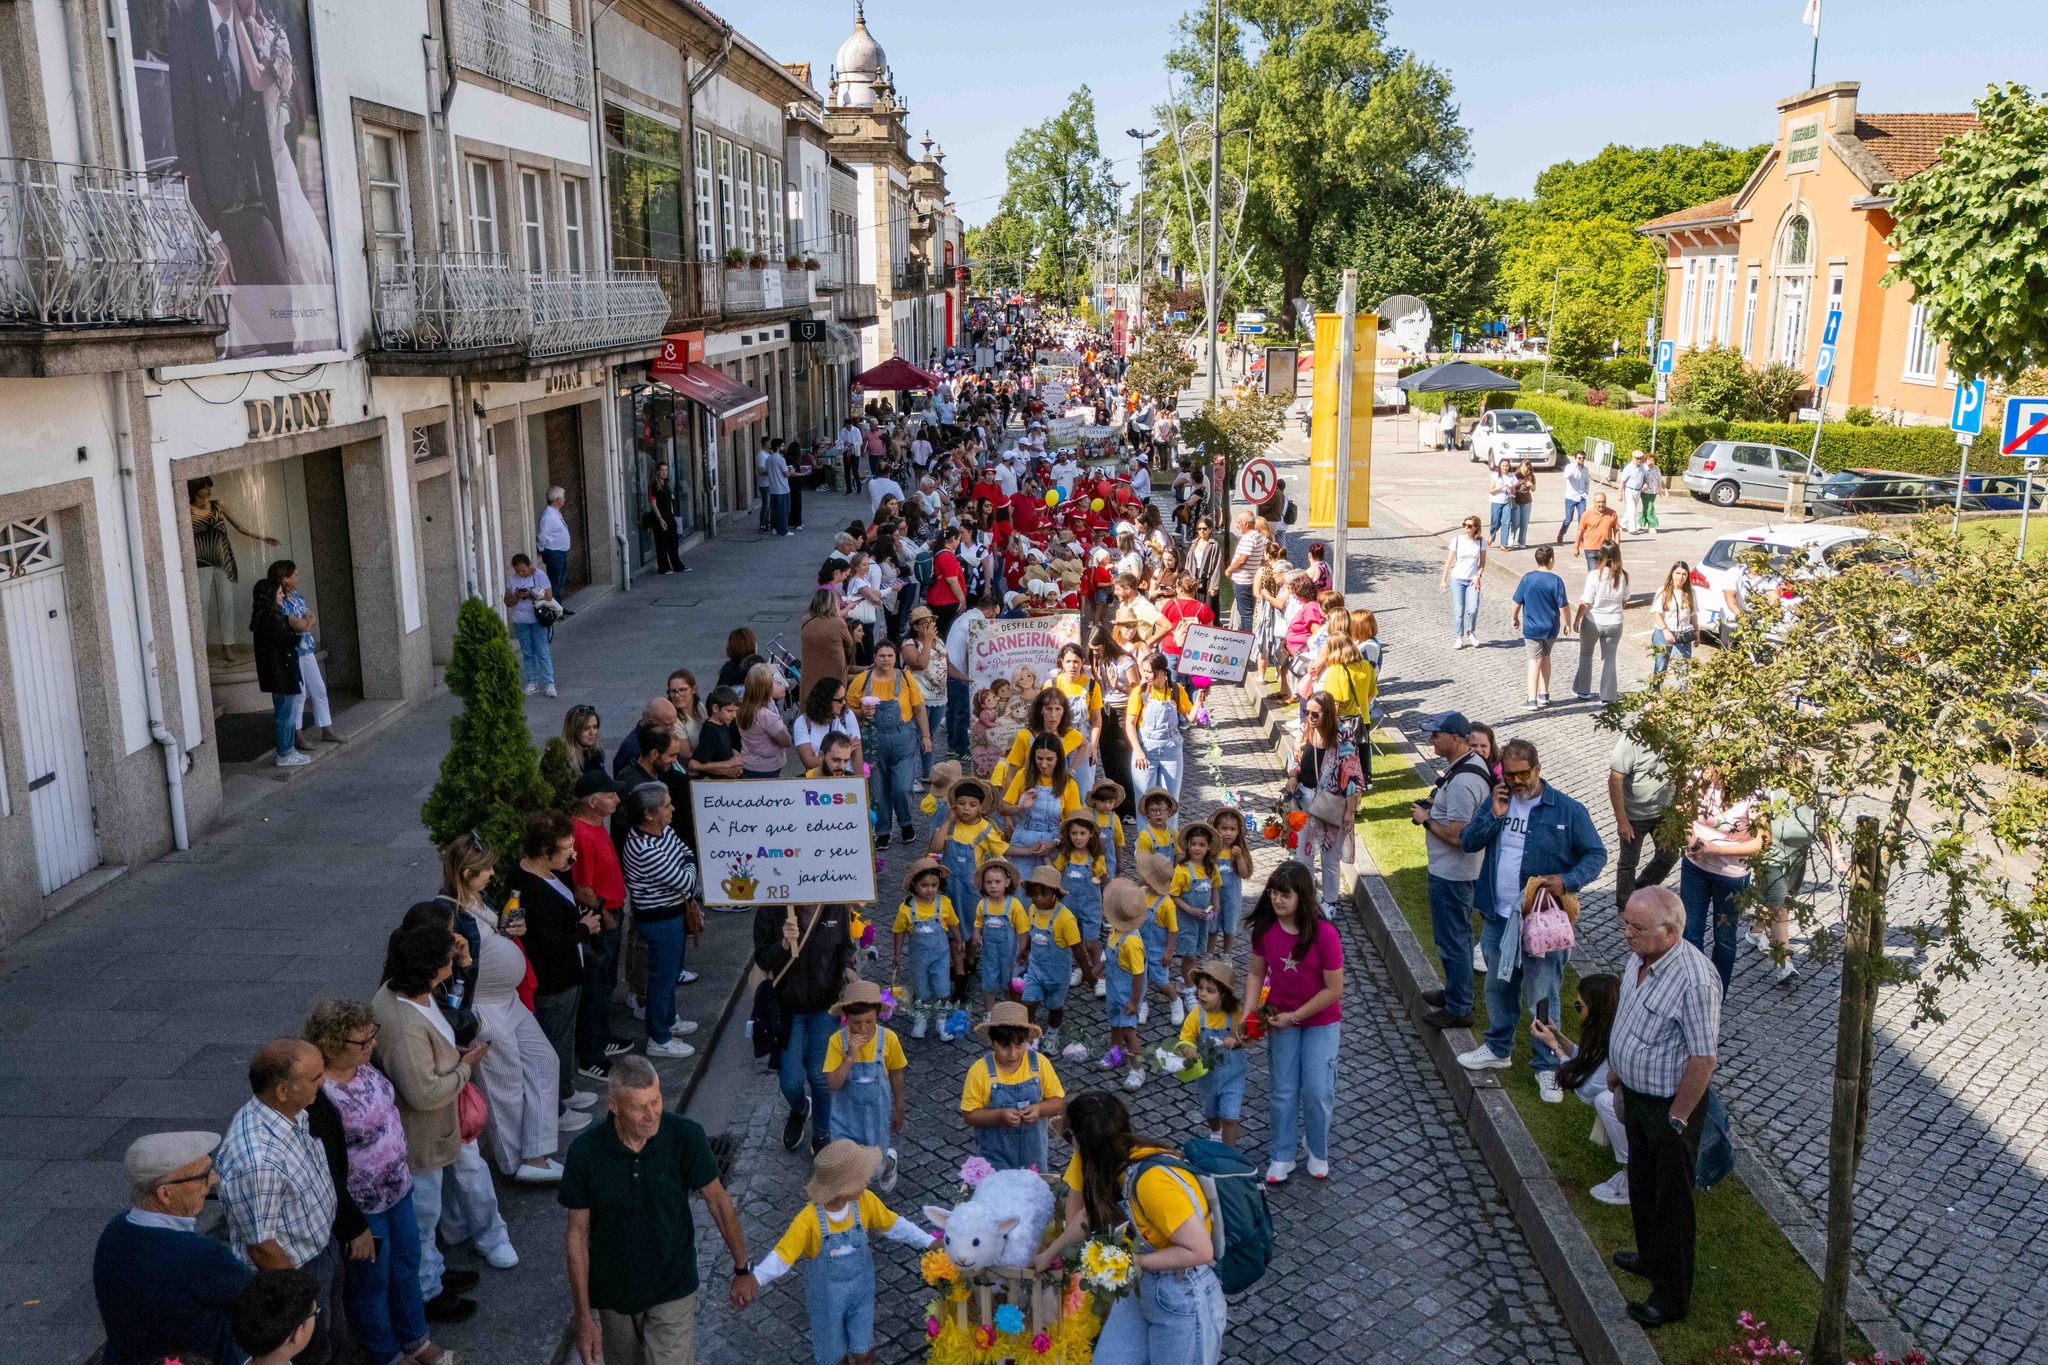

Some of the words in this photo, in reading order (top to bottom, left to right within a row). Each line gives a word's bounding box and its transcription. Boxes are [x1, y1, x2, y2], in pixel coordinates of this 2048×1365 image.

[1659, 343, 1671, 370] P
[1817, 350, 1831, 383] P
[1957, 384, 1978, 426] P
[244, 389, 335, 439] DANY
[1001, 621, 1034, 632] DESFILE
[1037, 621, 1049, 629] DO
[1194, 629, 1209, 639] Hoje
[1213, 634, 1246, 645] queremos
[1208, 643, 1228, 651] dizer
[992, 656, 1033, 670] Professora
[1183, 648, 1245, 668] OBRIGADA
[1210, 667, 1230, 676] tudo
[704, 795, 795, 808] Educadora
[804, 790, 858, 806] Rosa
[728, 820, 759, 837] flor
[765, 823, 798, 837] que
[806, 819, 858, 832] educa
[710, 849, 745, 859] com
[756, 846, 801, 859] Amor
[814, 847, 826, 857] o
[829, 846, 859, 857] seu
[797, 869, 858, 886] jardim.
[766, 885, 790, 899] RB
